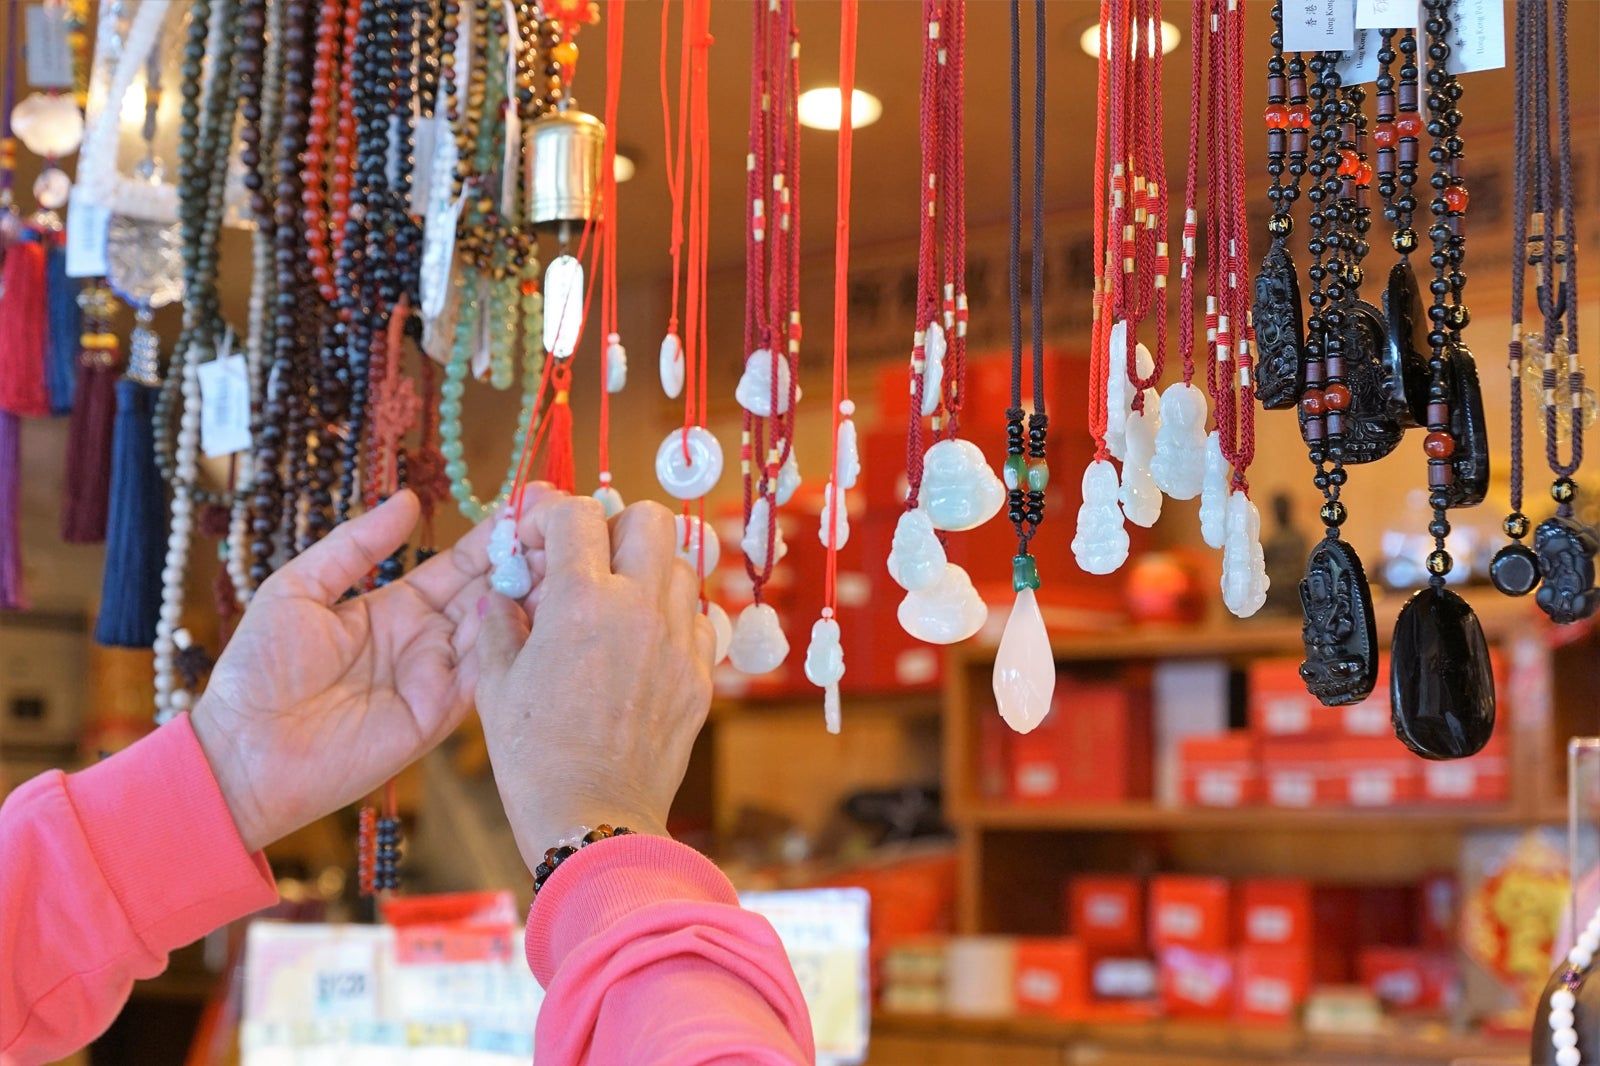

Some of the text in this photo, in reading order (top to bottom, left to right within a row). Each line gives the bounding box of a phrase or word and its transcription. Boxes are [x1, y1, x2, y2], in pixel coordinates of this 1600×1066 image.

[1305, 0, 1317, 27] 香港
[1325, 0, 1335, 35] Hong Kong
[1358, 32, 1368, 51] Kong
